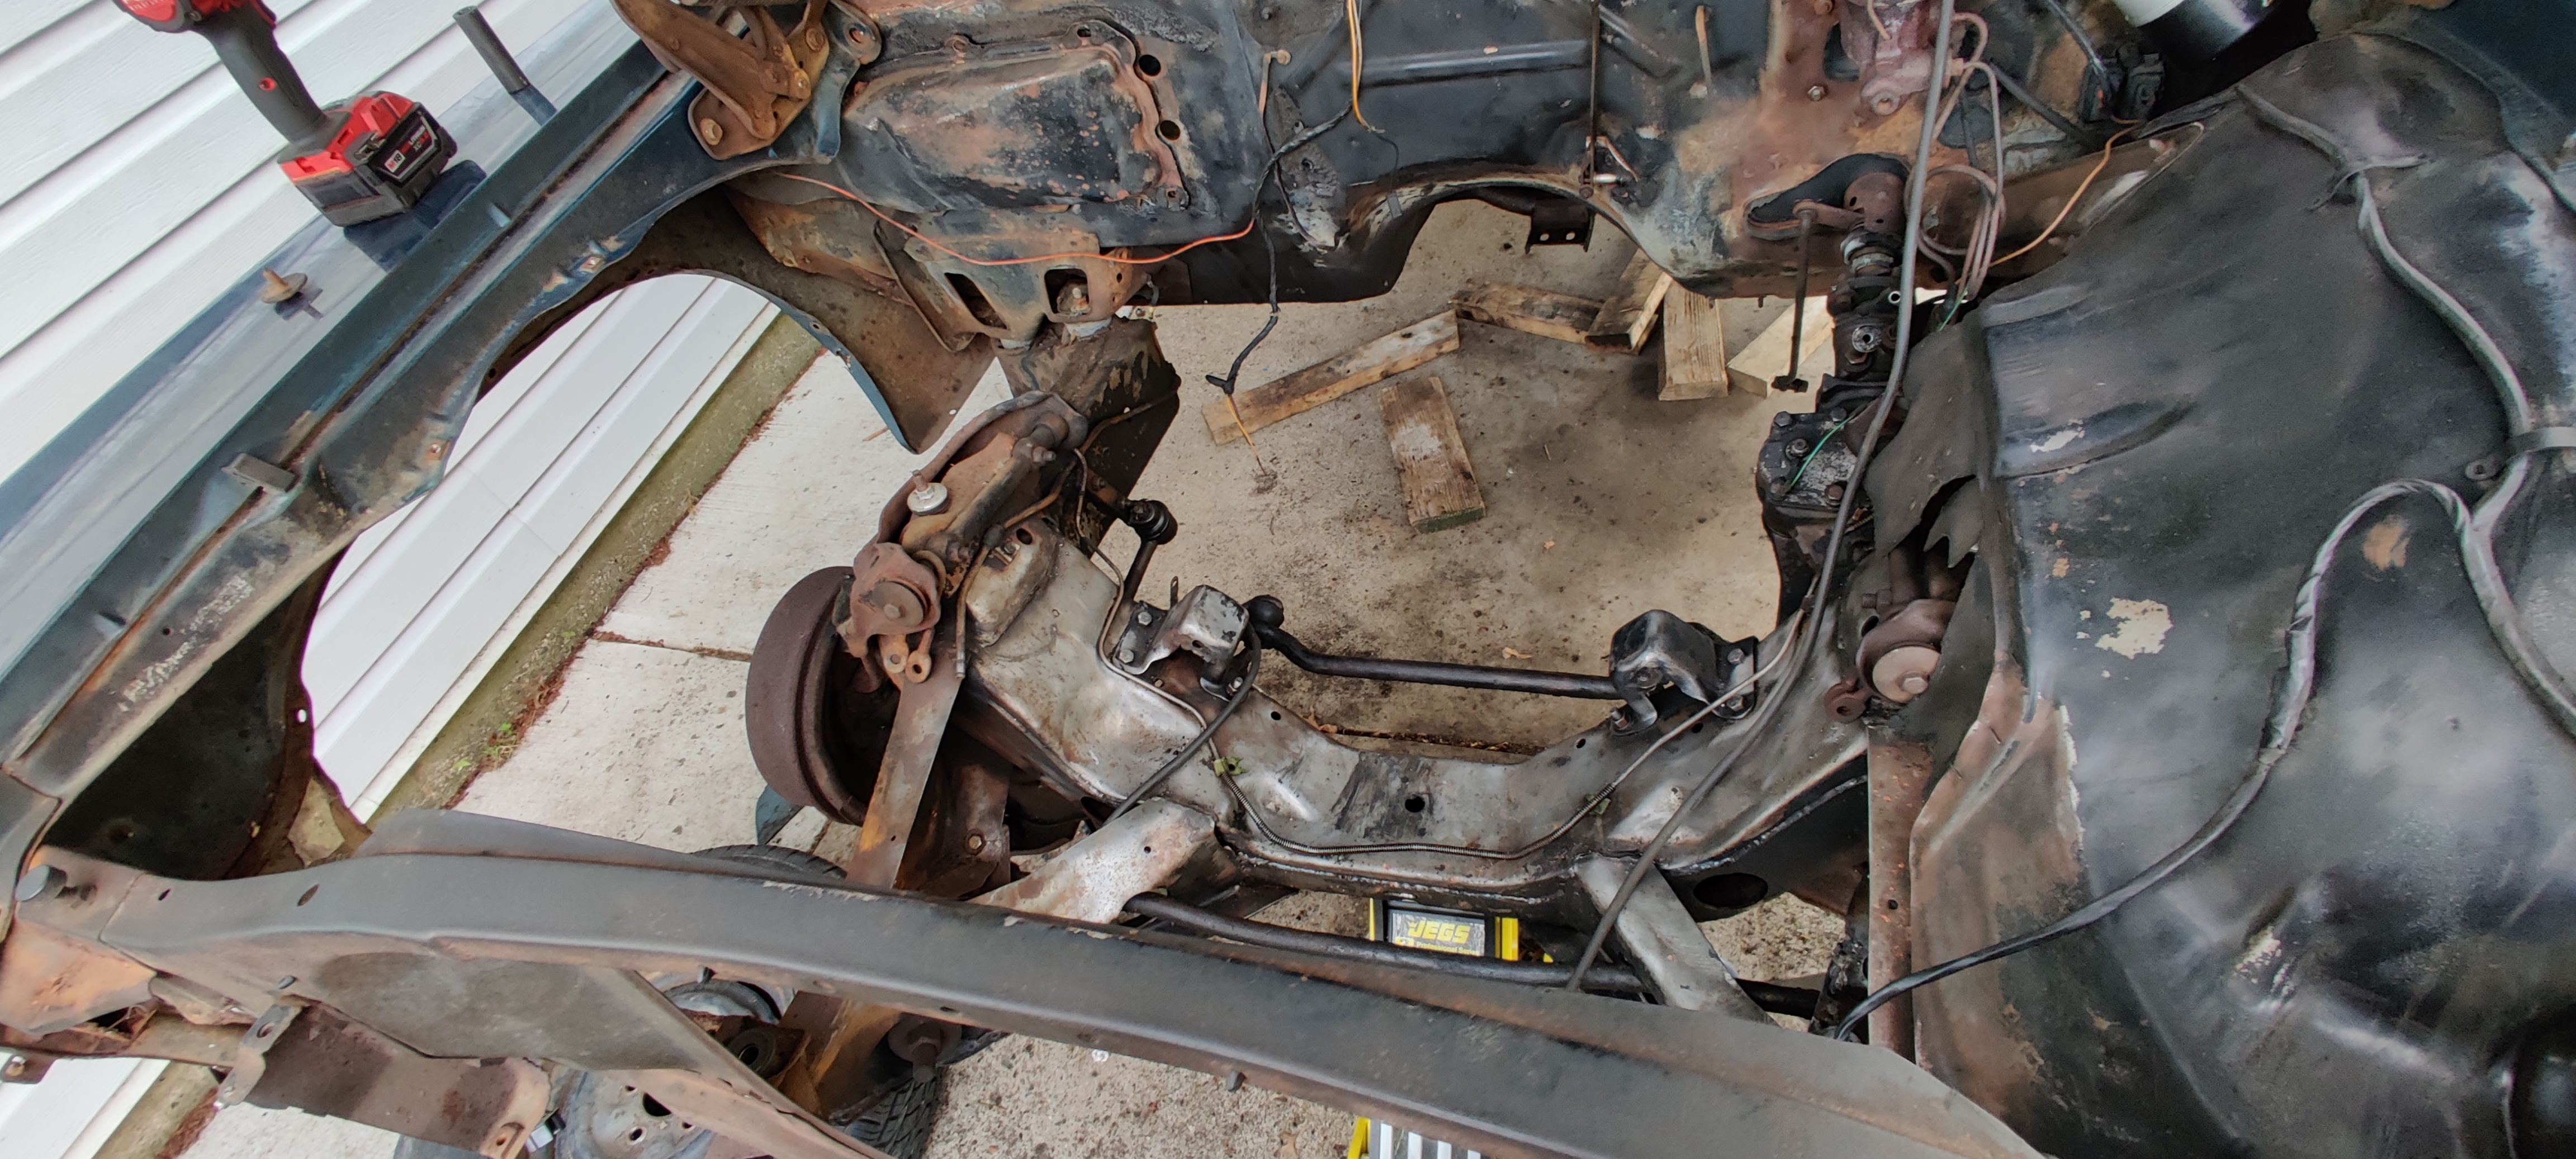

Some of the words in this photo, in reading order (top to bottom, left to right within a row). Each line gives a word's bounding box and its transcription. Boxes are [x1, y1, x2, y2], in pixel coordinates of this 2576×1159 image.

[387, 153, 402, 170] M18
[1408, 920, 1470, 943] JEGS
[1416, 941, 1457, 953] Professional
[1459, 947, 1481, 956] Series
